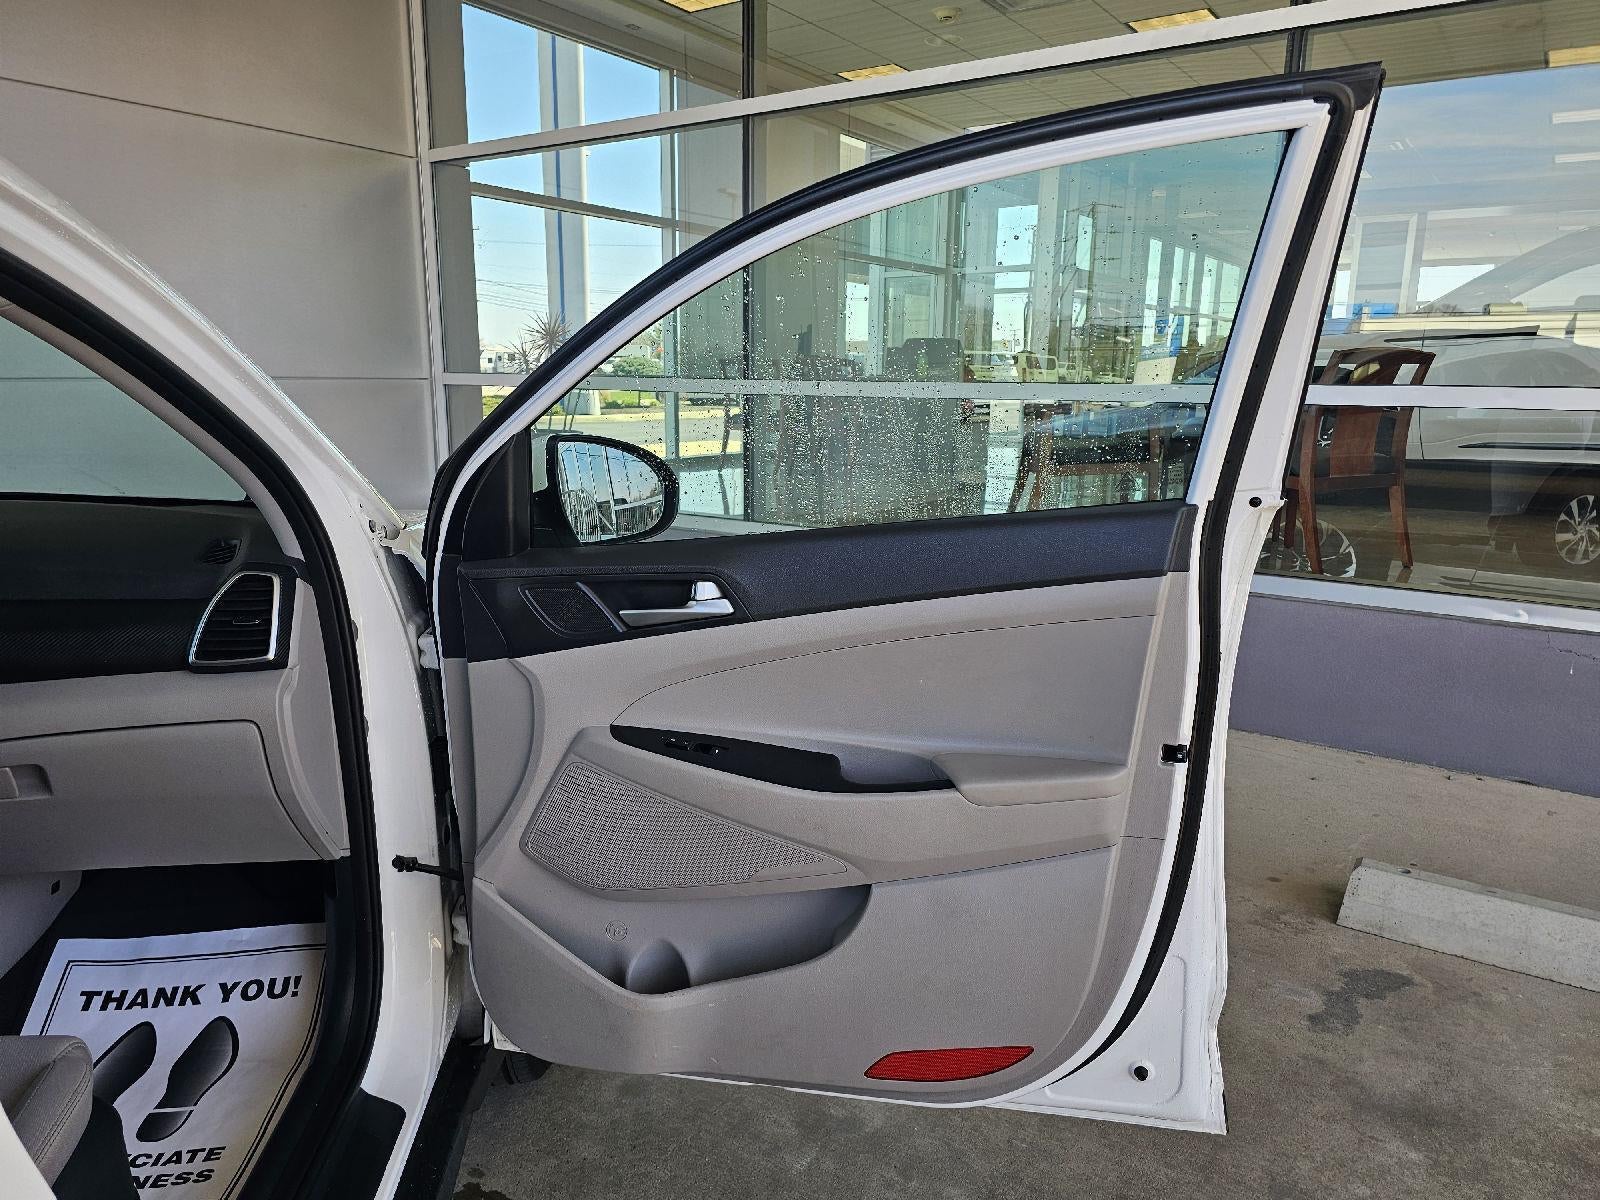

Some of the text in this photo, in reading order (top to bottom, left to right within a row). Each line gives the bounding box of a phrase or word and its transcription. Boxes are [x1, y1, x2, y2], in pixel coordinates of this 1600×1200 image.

[80, 975, 302, 1011] THANK YOU!
[127, 1146, 226, 1168] CIATE
